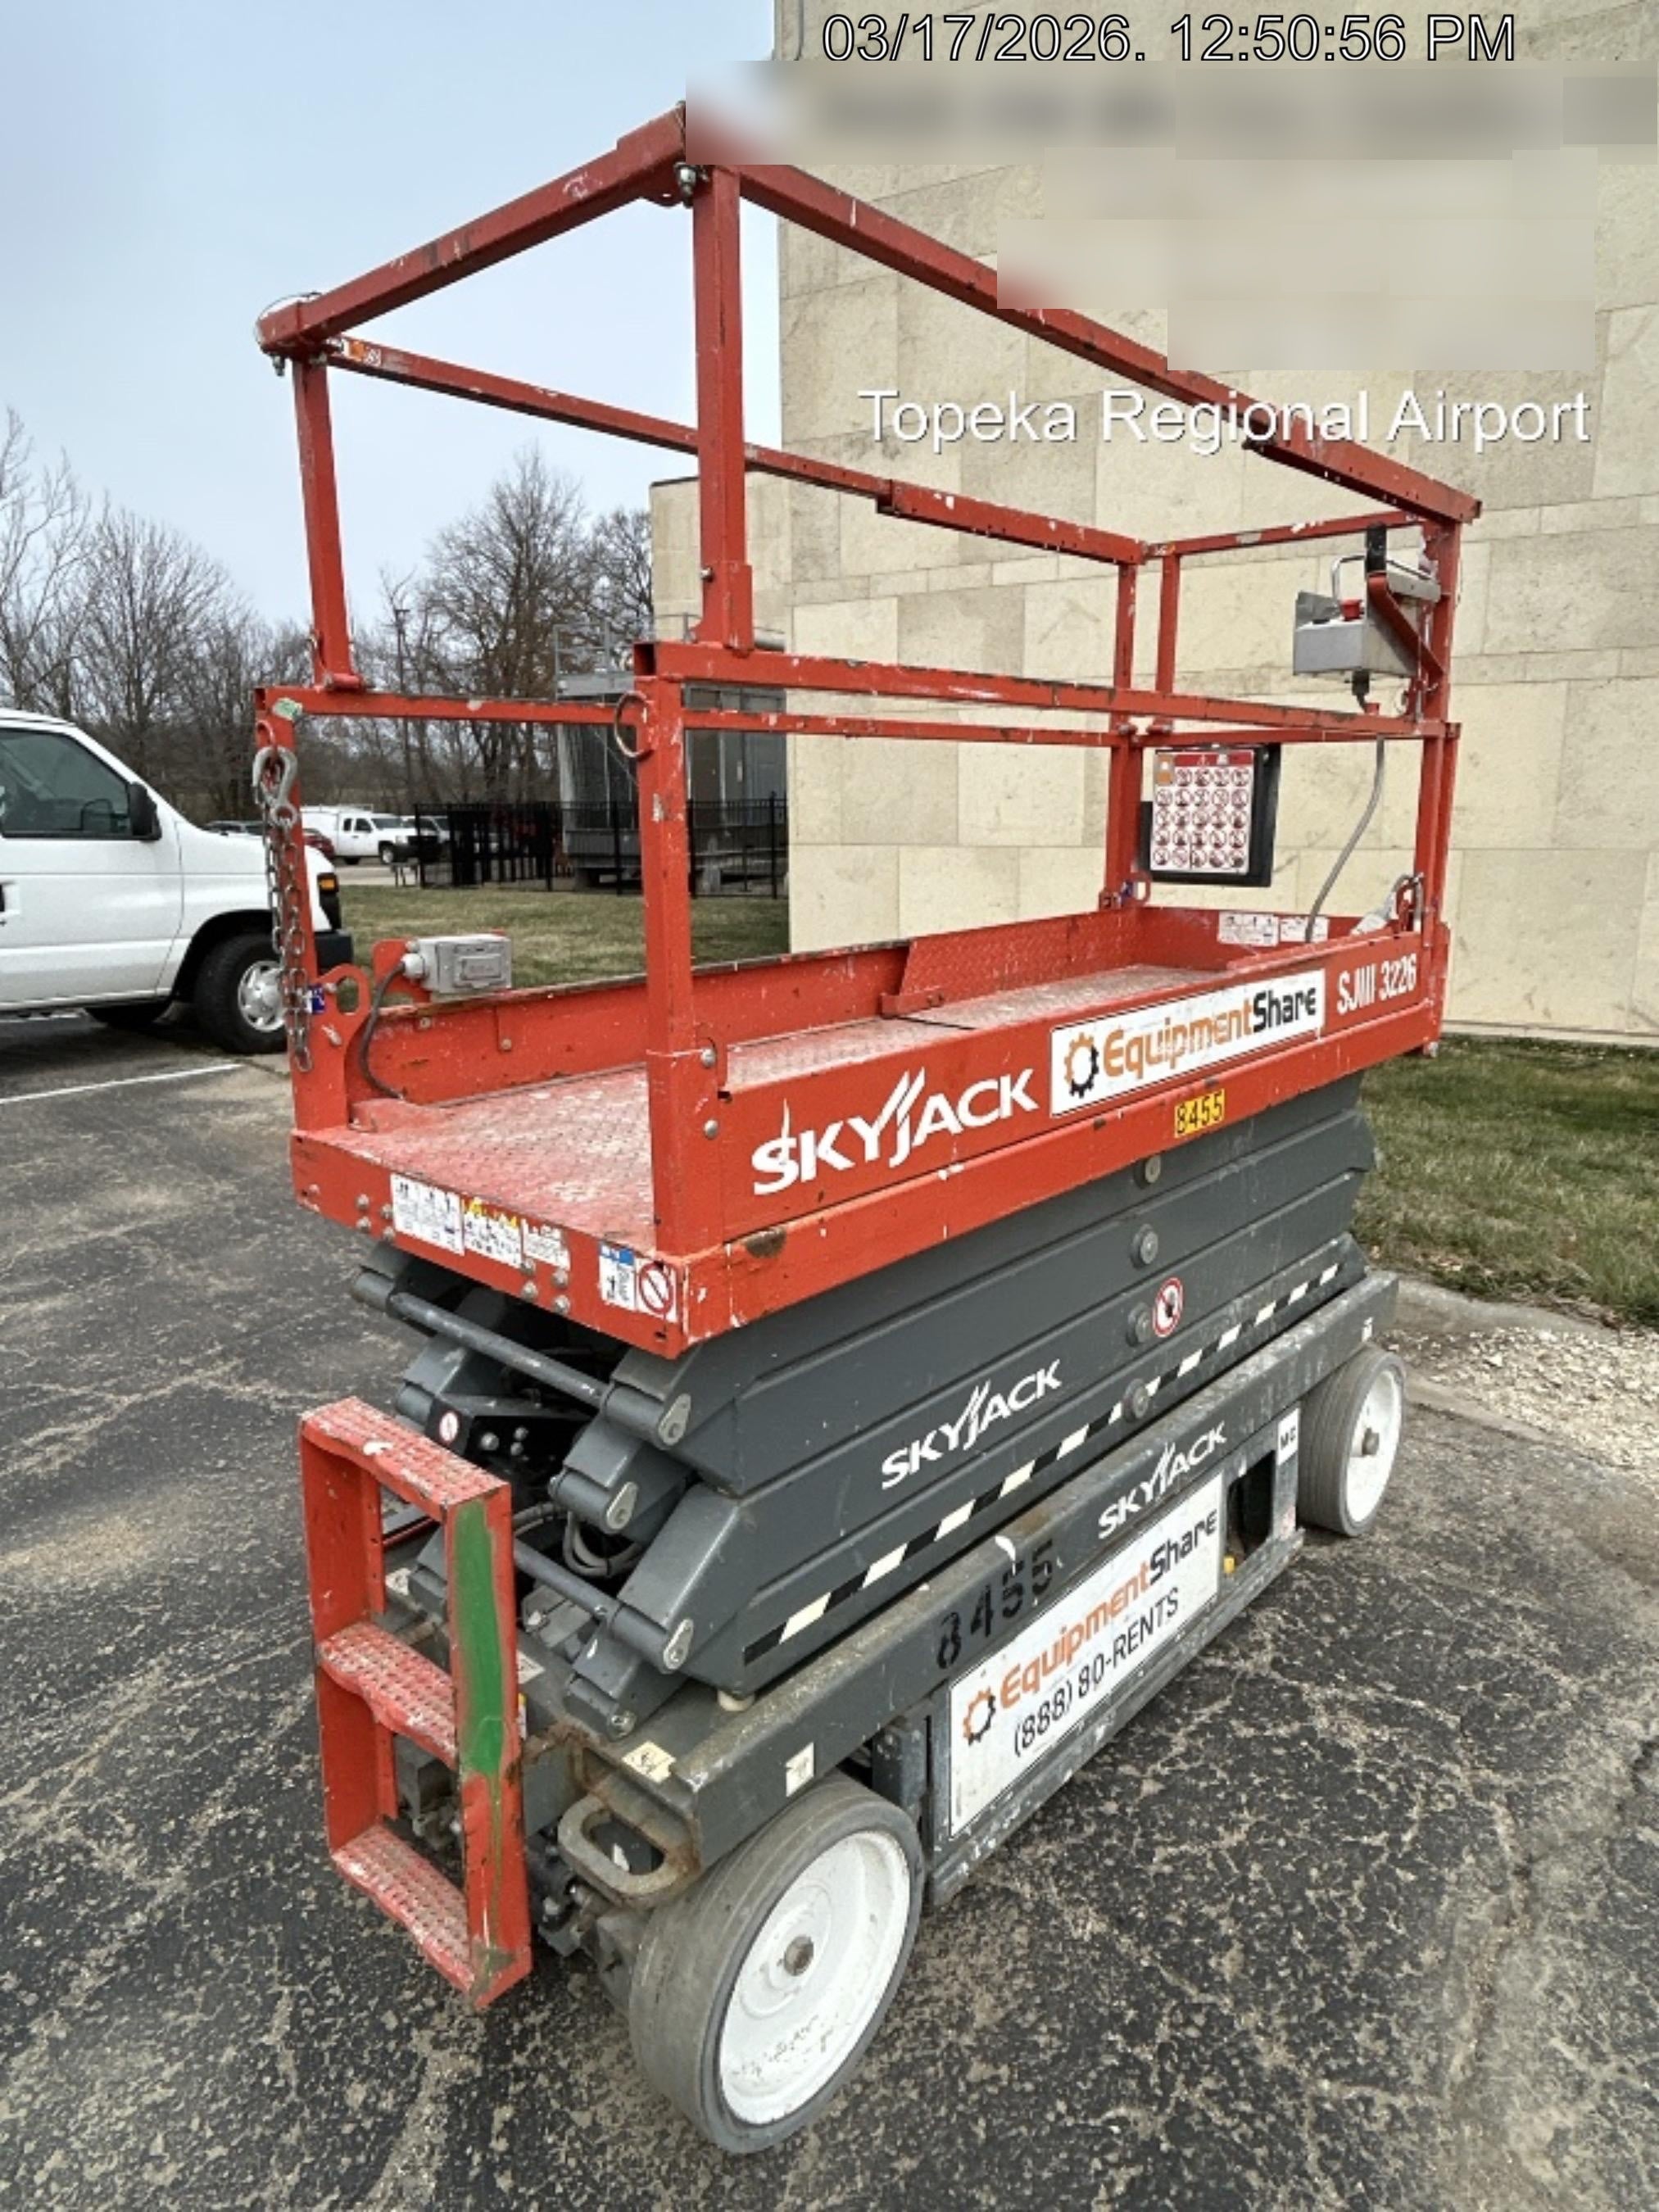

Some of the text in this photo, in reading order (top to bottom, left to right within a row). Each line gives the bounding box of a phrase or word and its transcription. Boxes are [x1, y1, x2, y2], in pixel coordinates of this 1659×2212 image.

[1103, 987, 1317, 1080] EquipmentShare
[1379, 953, 1417, 1002] 3226
[751, 1067, 1036, 1196] SKYJACK
[1177, 1090, 1222, 1134] 8455
[882, 1358, 1062, 1489] SKYJACK
[1098, 1421, 1227, 1539] SKYJACK
[937, 1539, 1054, 1669] 8455
[999, 1508, 1217, 1708] EquipmentShare
[1014, 1587, 1179, 1756] (888) 80-RENTS
